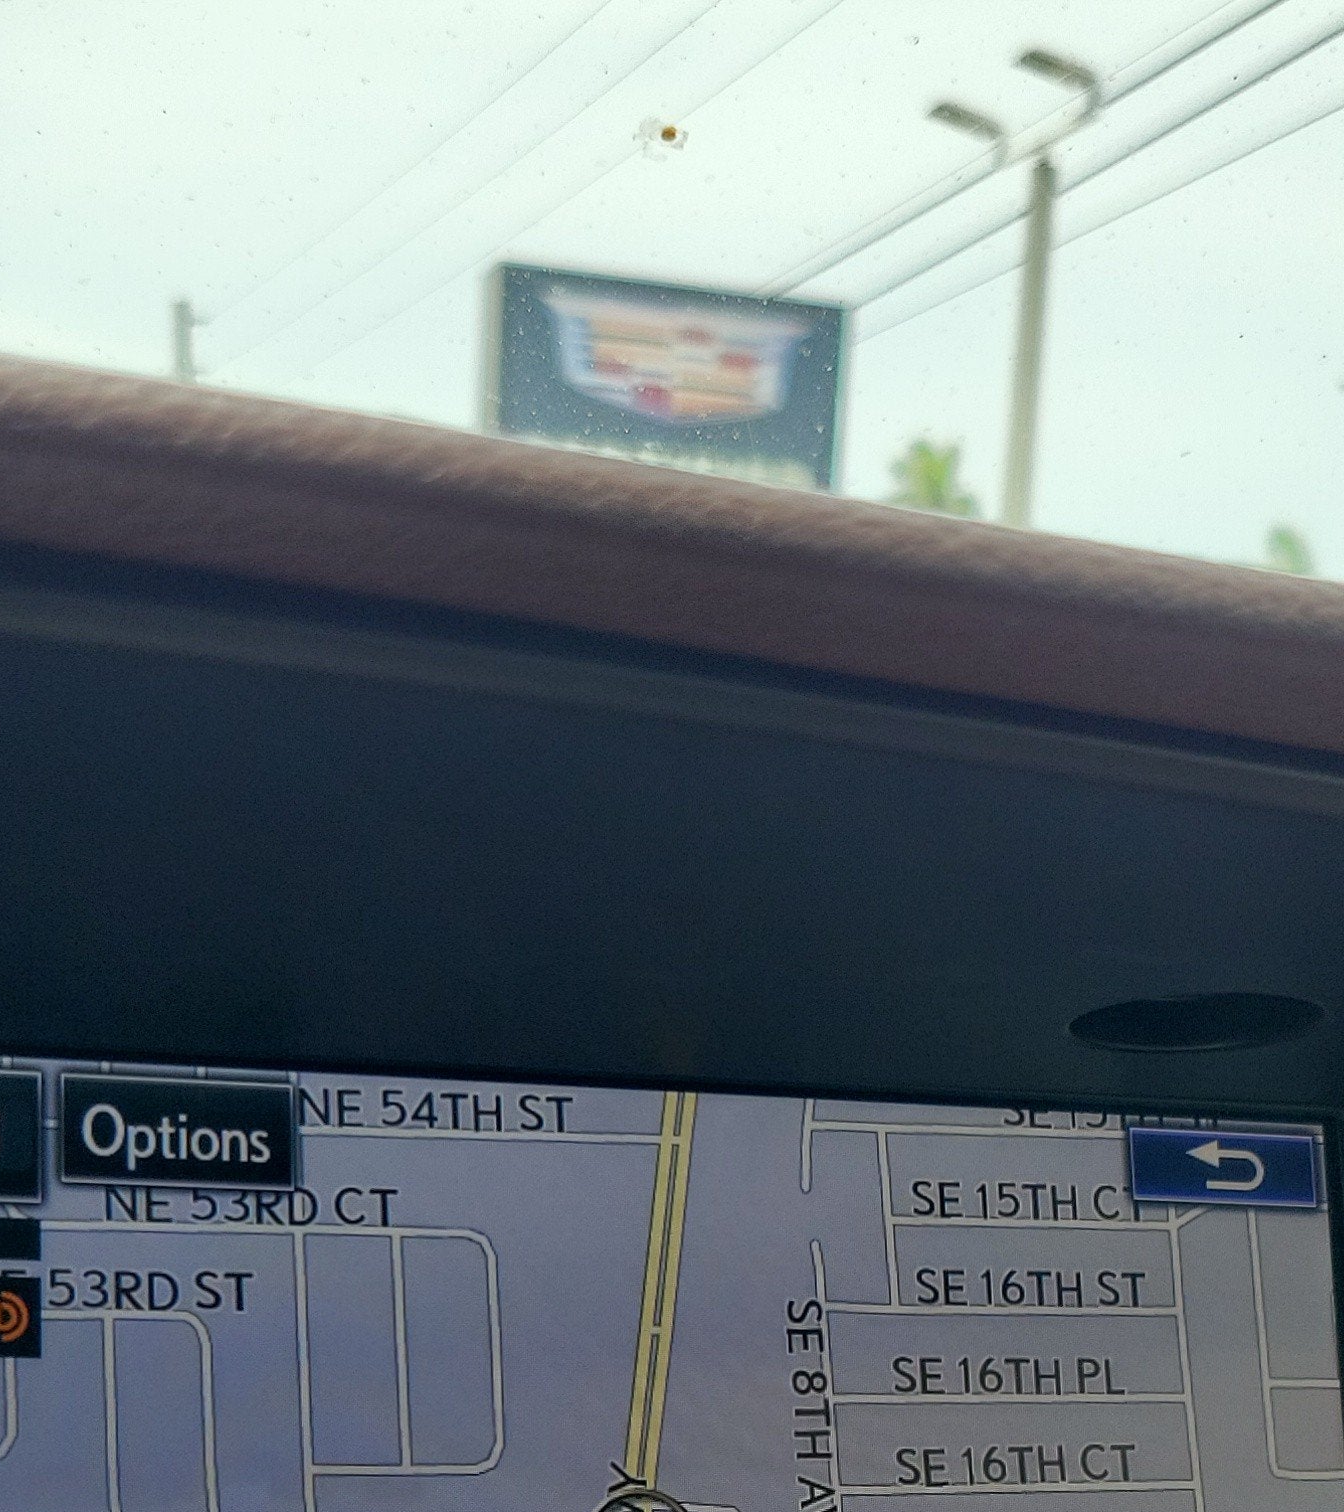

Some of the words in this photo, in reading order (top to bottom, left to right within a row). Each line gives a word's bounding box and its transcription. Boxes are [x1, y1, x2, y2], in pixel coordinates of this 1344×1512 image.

[300, 1088, 362, 1128] NE
[381, 1090, 502, 1132] 54TH
[519, 1095, 573, 1132] ST
[82, 1103, 271, 1170] Options
[105, 1188, 173, 1223] NE
[190, 1189, 317, 1226] 53RD
[334, 1187, 398, 1226] CT
[912, 1181, 961, 1218] SE
[976, 1184, 1078, 1220] 15TH
[47, 1270, 178, 1311] 53RD
[196, 1271, 254, 1311] ST
[916, 1269, 965, 1306] SE
[979, 1270, 1083, 1308] 16TH
[1097, 1271, 1146, 1308] ST
[786, 1300, 824, 1354] SE
[893, 1357, 942, 1395] SE
[958, 1358, 1061, 1396] 16TH
[1077, 1359, 1125, 1396] PL
[791, 1370, 833, 1459] 8TH
[896, 1448, 947, 1487] SE
[959, 1447, 1066, 1485] 16TH
[1080, 1444, 1136, 1482] CT
